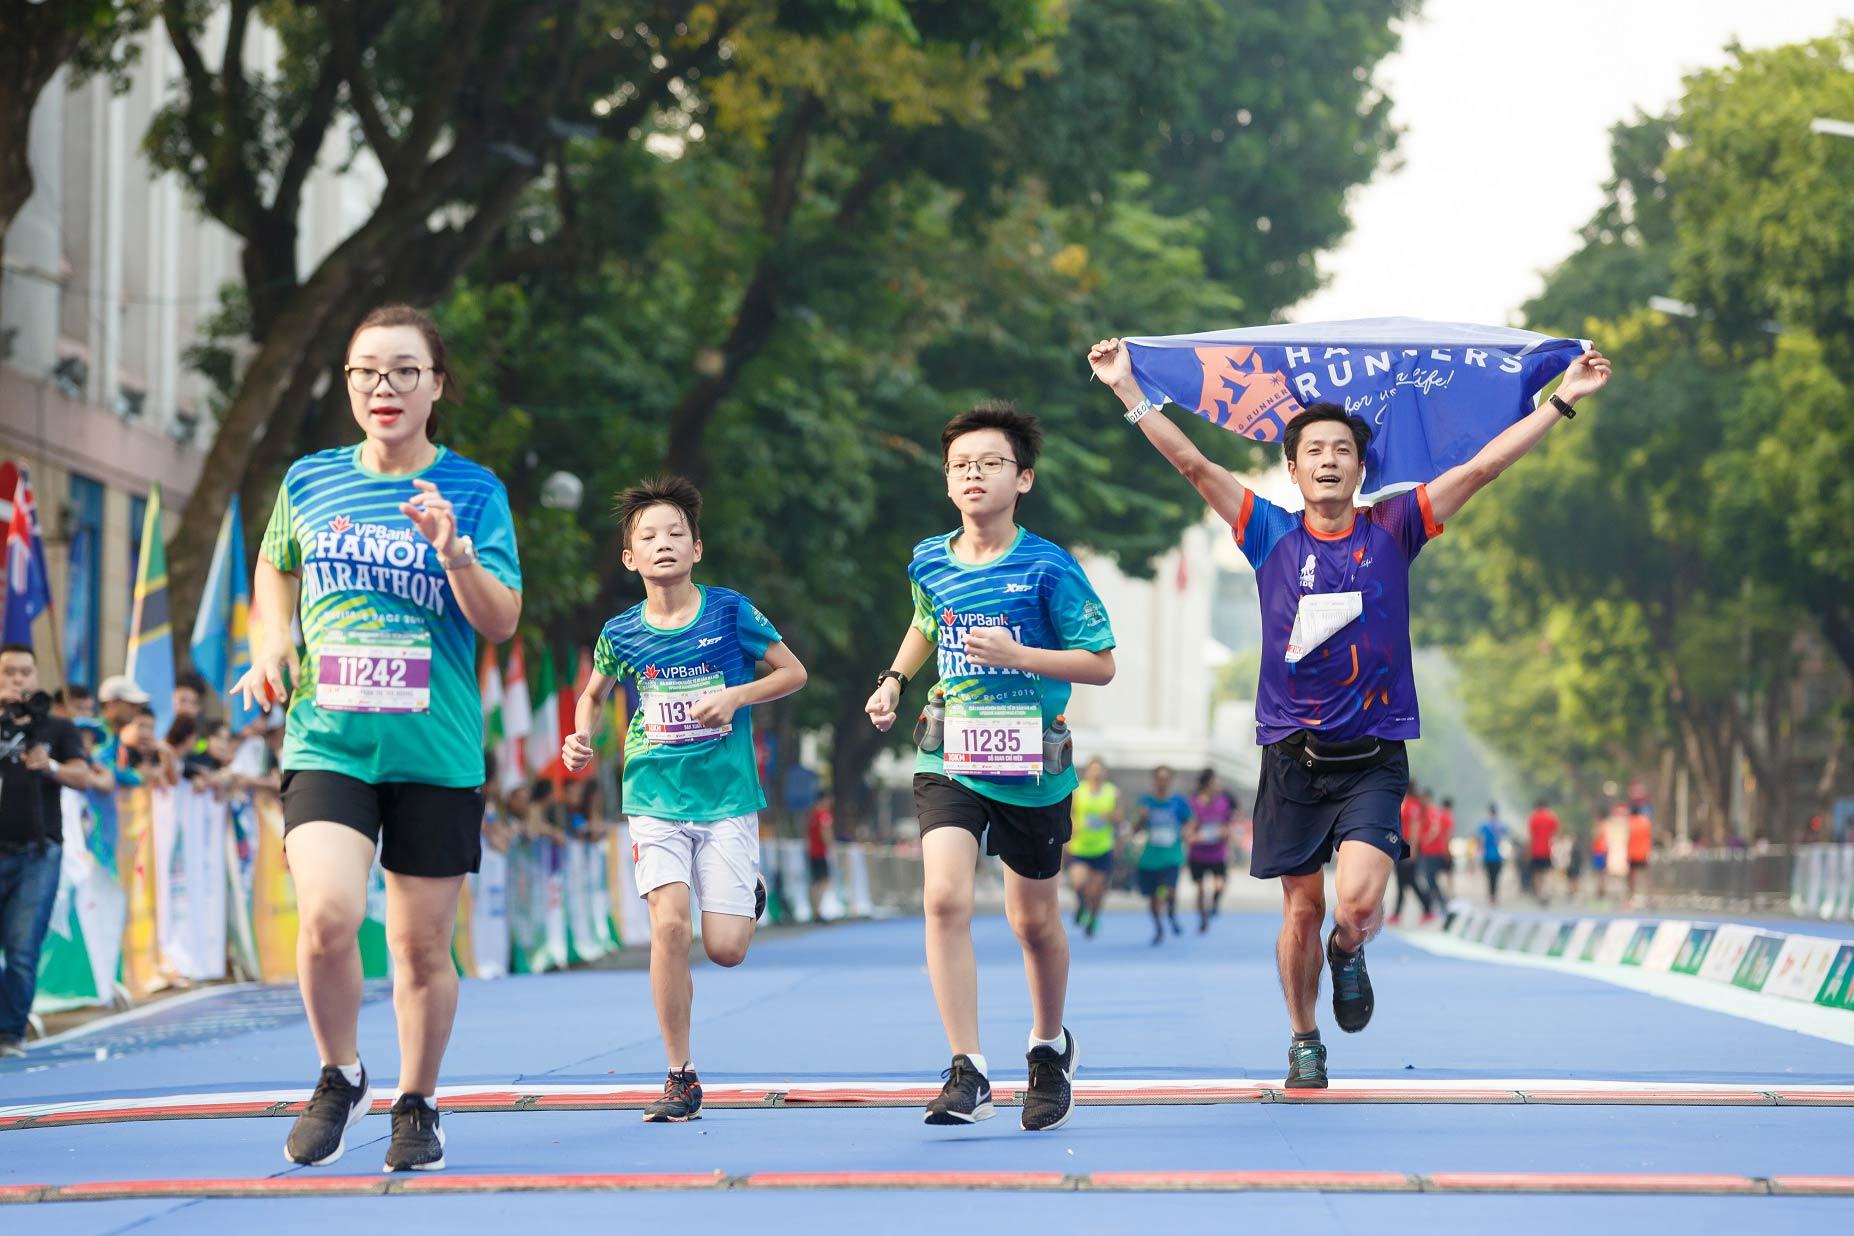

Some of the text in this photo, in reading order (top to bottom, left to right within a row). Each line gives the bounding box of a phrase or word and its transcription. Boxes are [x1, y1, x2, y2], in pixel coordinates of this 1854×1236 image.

[354, 523, 414, 541] VPBank
[315, 531, 428, 570] HANOI
[959, 613, 1009, 626] VPBank
[338, 656, 407, 687] 11242
[661, 662, 710, 679] VPBank
[658, 700, 701, 723] 1131
[962, 729, 1021, 752] 11235
